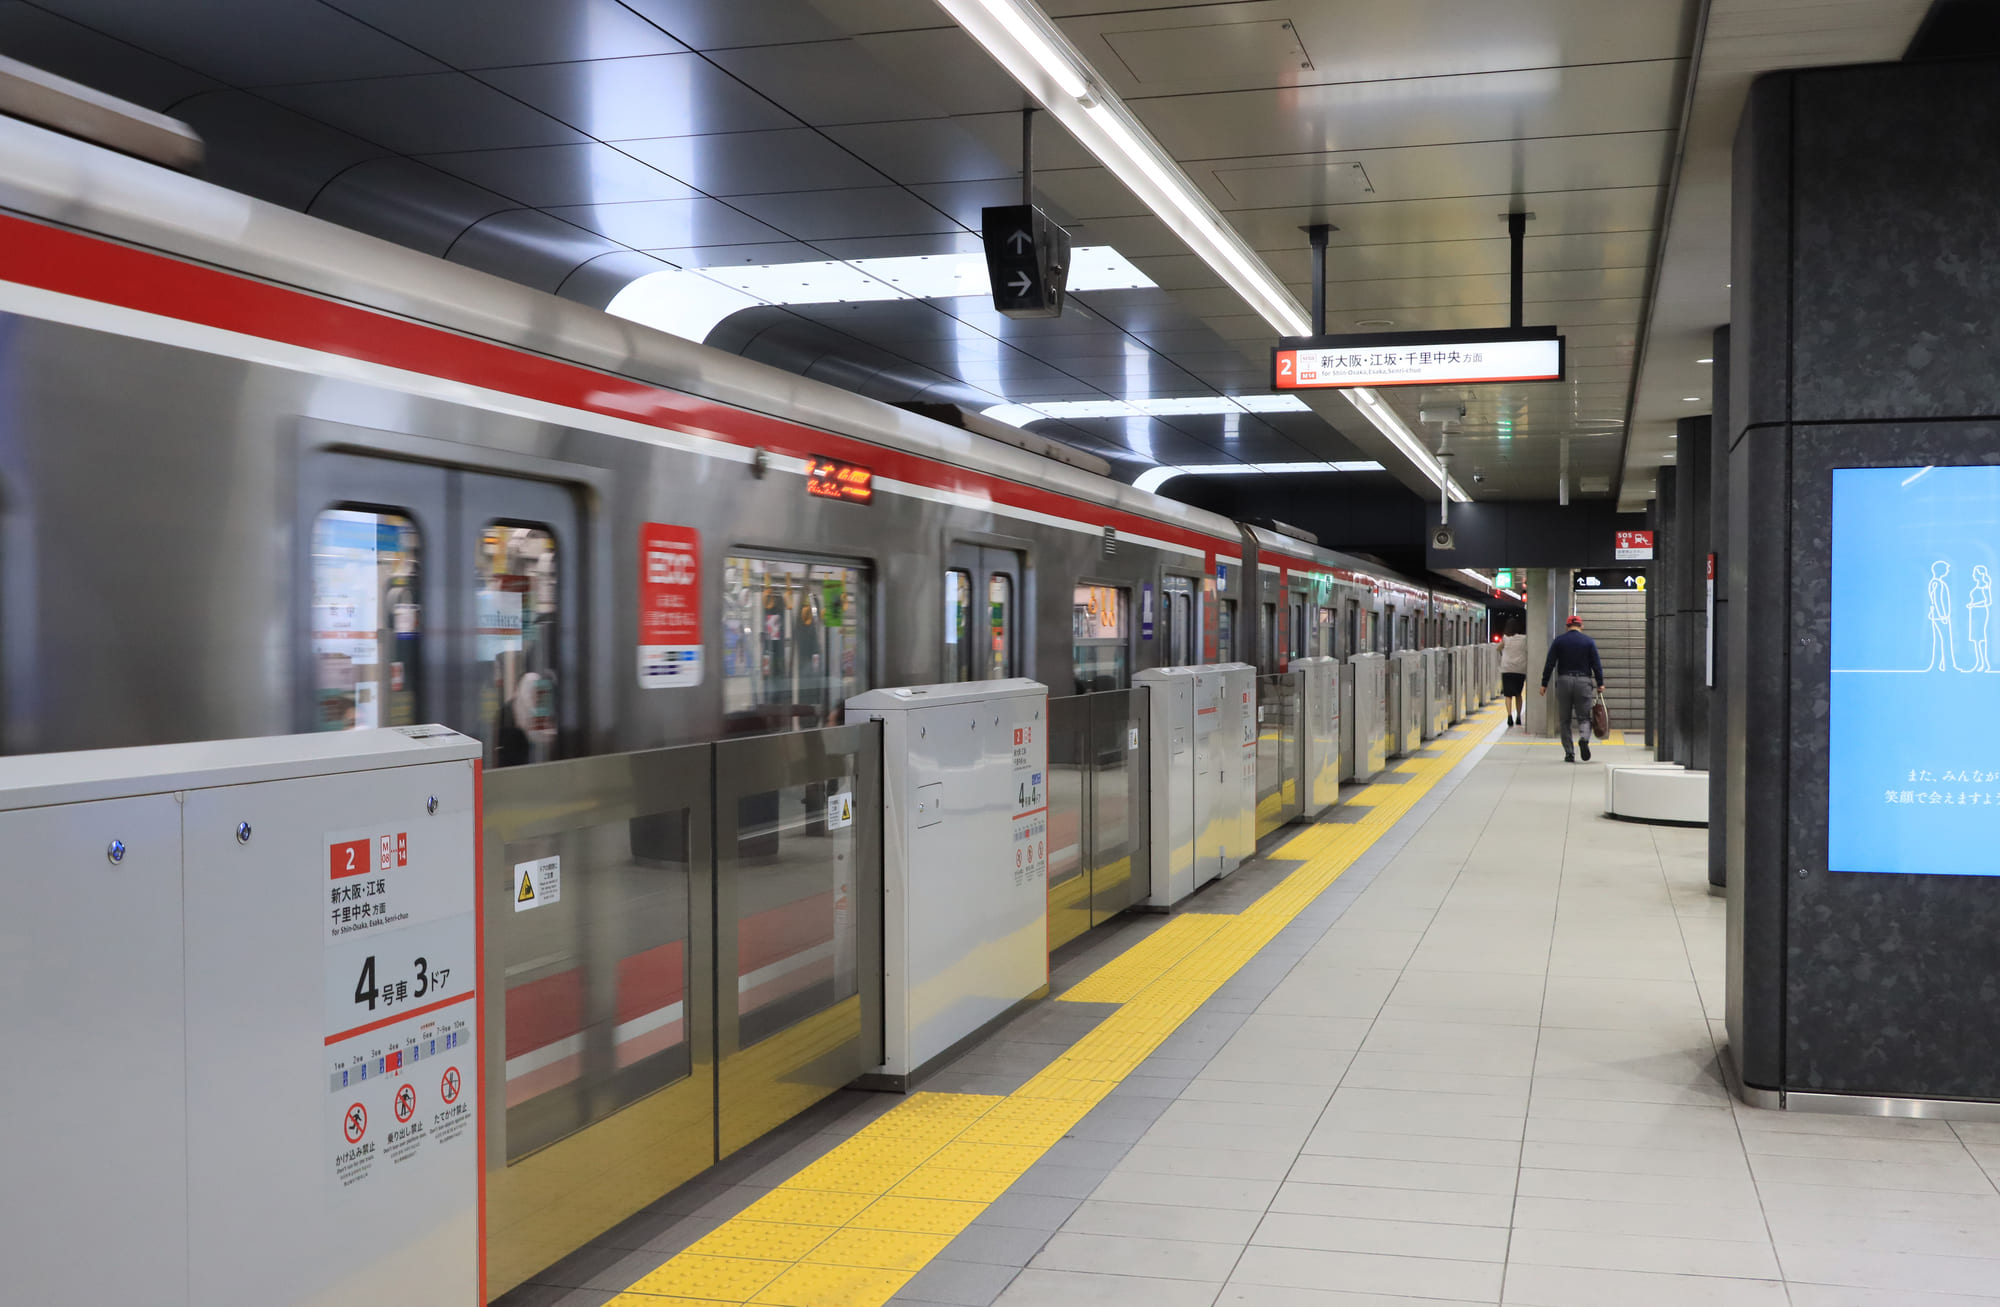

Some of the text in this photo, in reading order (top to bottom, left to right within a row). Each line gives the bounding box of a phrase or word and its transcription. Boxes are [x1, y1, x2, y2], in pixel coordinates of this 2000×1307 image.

[1280, 358, 1292, 375] 2
[345, 847, 356, 871] 2
[398, 851, 406, 861] 14
[331, 879, 386, 904] 新大阪・江坂
[331, 928, 339, 936] for
